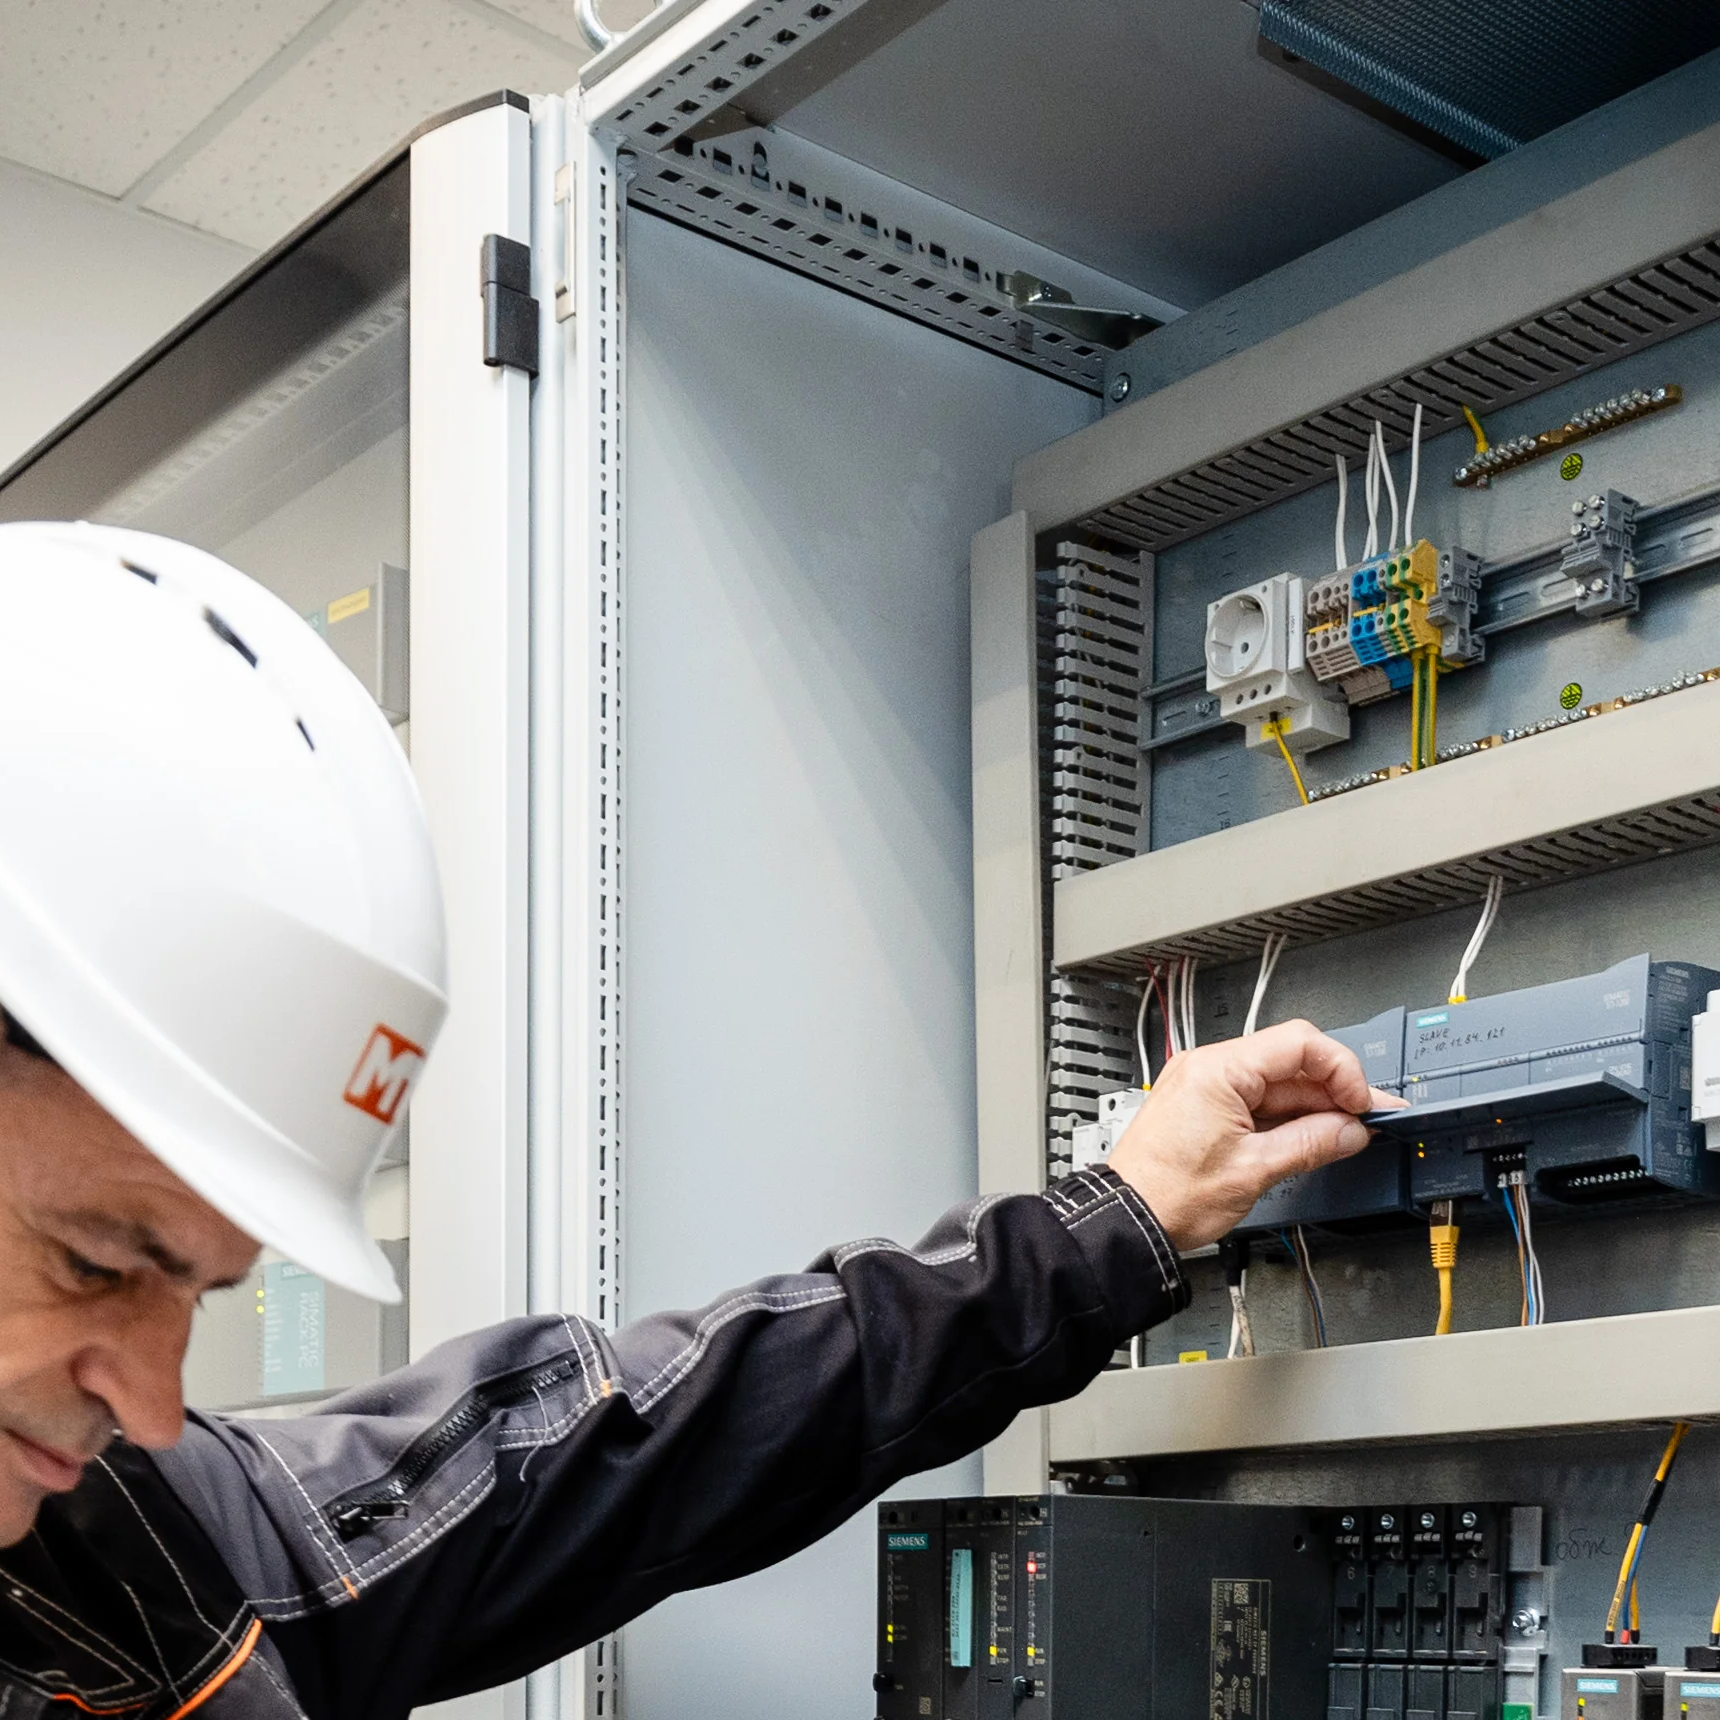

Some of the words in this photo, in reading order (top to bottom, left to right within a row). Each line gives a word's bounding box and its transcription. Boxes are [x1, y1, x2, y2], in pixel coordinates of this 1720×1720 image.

[1419, 1028, 1450, 1044] SLAVE
[887, 1535, 927, 1548] SIEMENS
[1579, 1681, 1616, 1691] SIEMENS
[1683, 1685, 1720, 1695] SIEMENS
